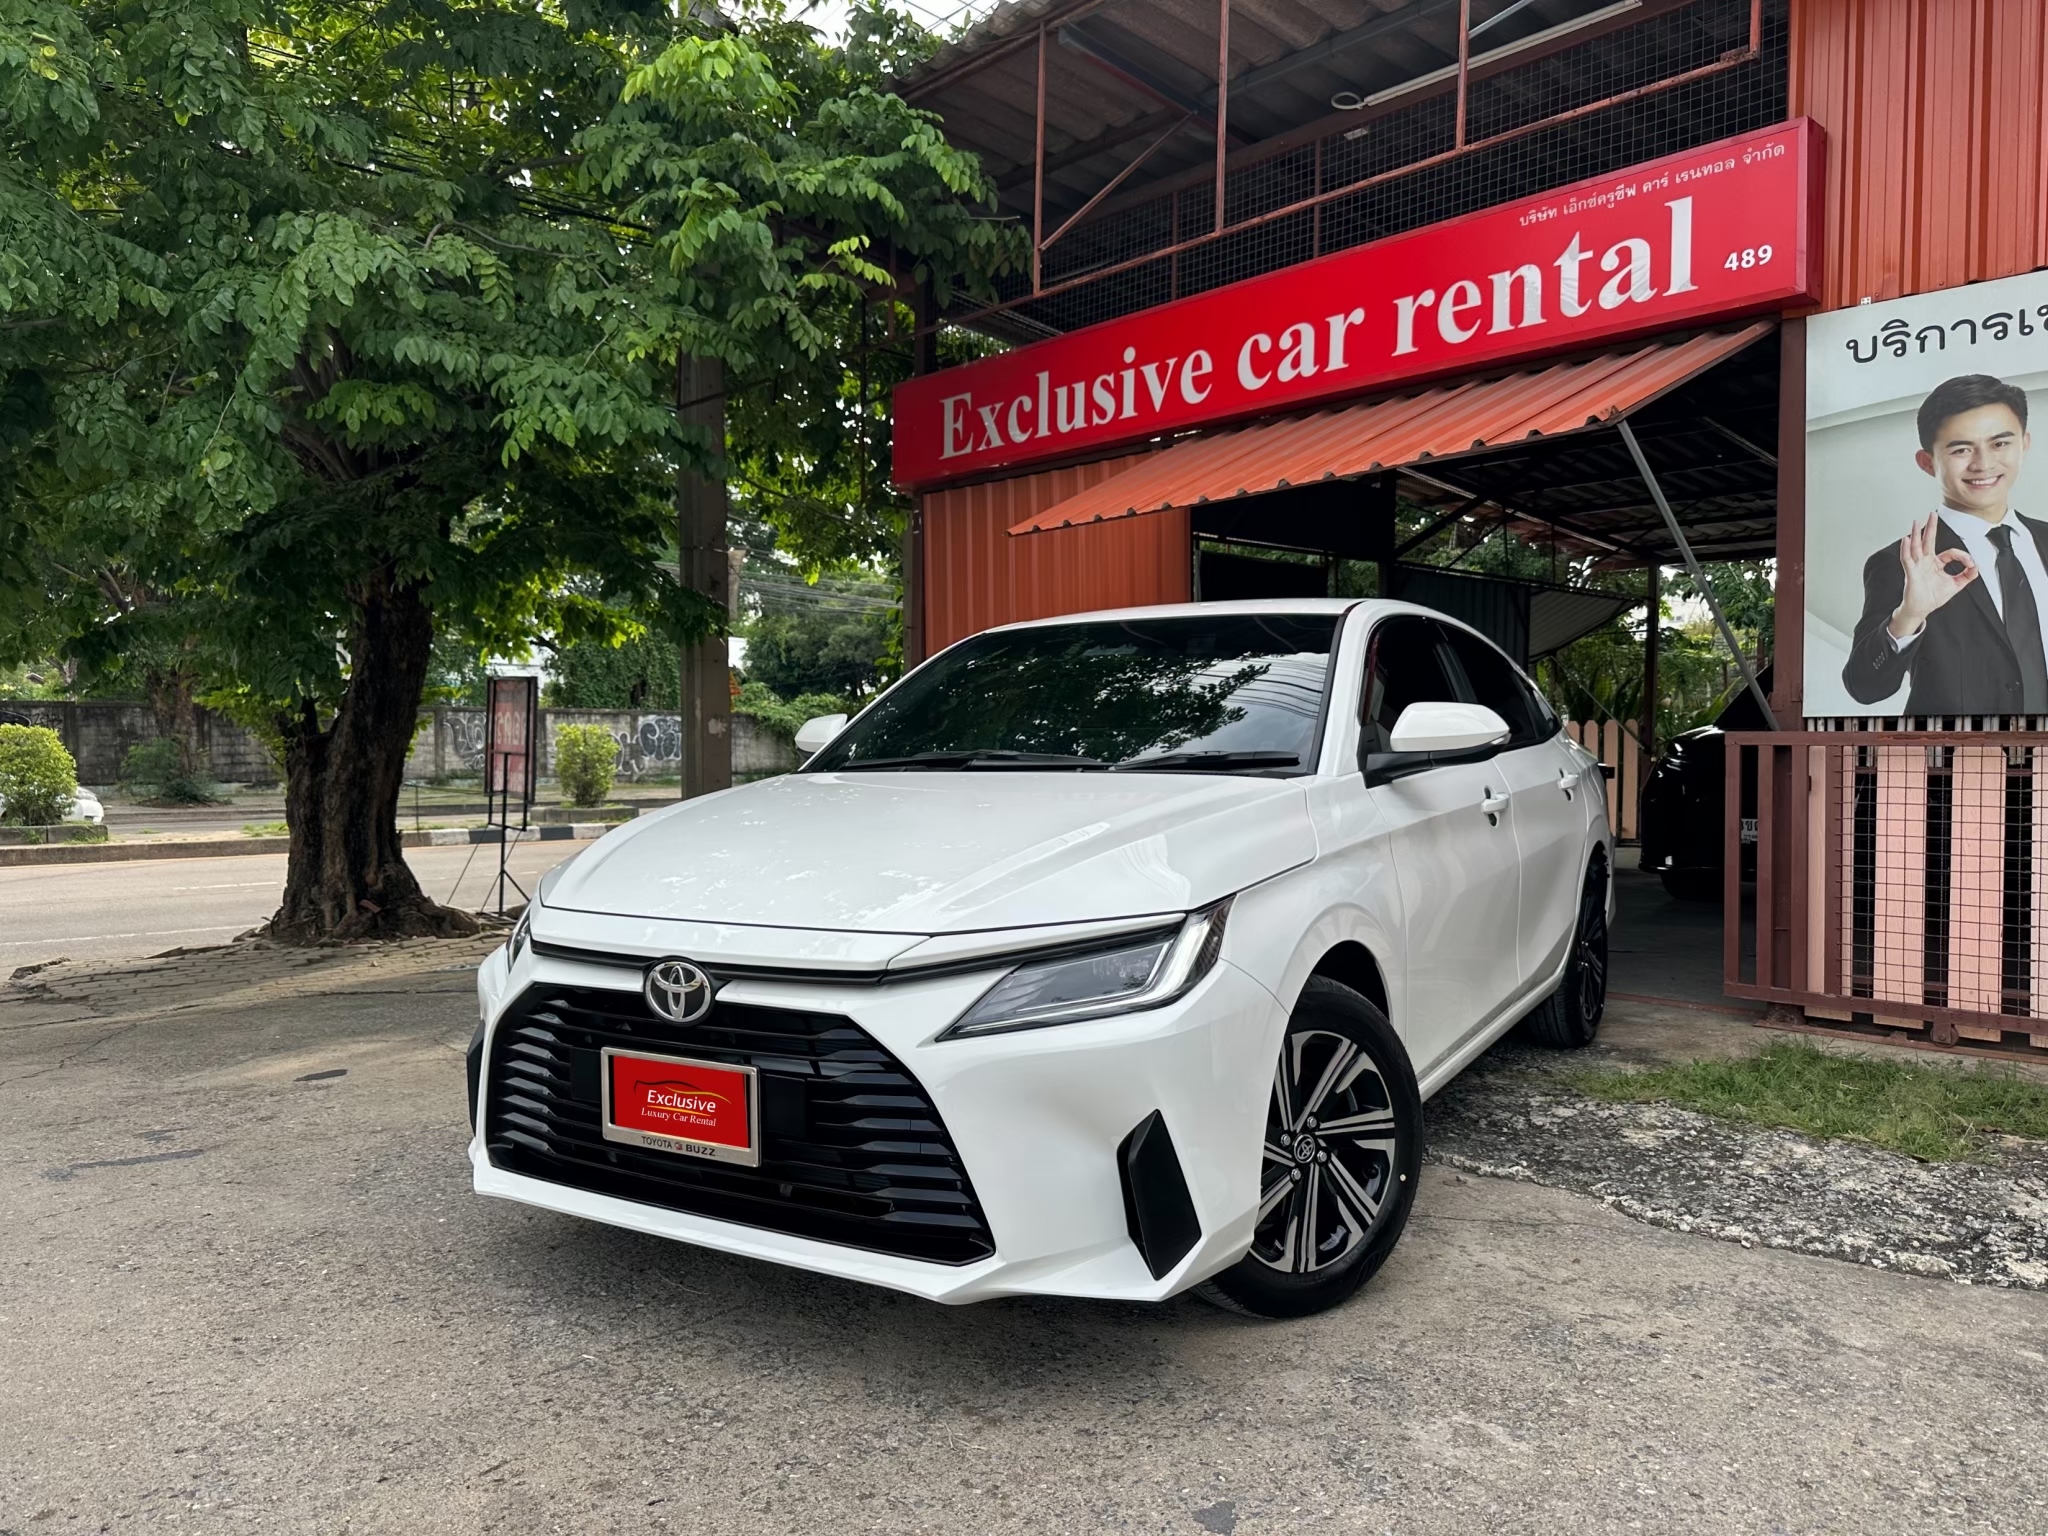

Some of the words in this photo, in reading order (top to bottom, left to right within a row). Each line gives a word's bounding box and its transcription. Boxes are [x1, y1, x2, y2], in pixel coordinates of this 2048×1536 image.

[1519, 206, 1558, 226] บริษัท
[1643, 171, 1669, 193] คาร์
[1675, 158, 1736, 184] เรนทอล
[1742, 142, 1785, 165] จำกัด
[1724, 244, 1773, 272] 489
[939, 347, 1213, 461] Exclusive
[1237, 307, 1365, 391] car
[1391, 195, 1699, 357] rental
[647, 1089, 716, 1113] Exclusive
[641, 1107, 671, 1121] Luxury
[673, 1112, 688, 1122] Car
[690, 1115, 717, 1126] Rental
[641, 1135, 673, 1149] TOYOTA
[686, 1144, 716, 1156] BUZZ
